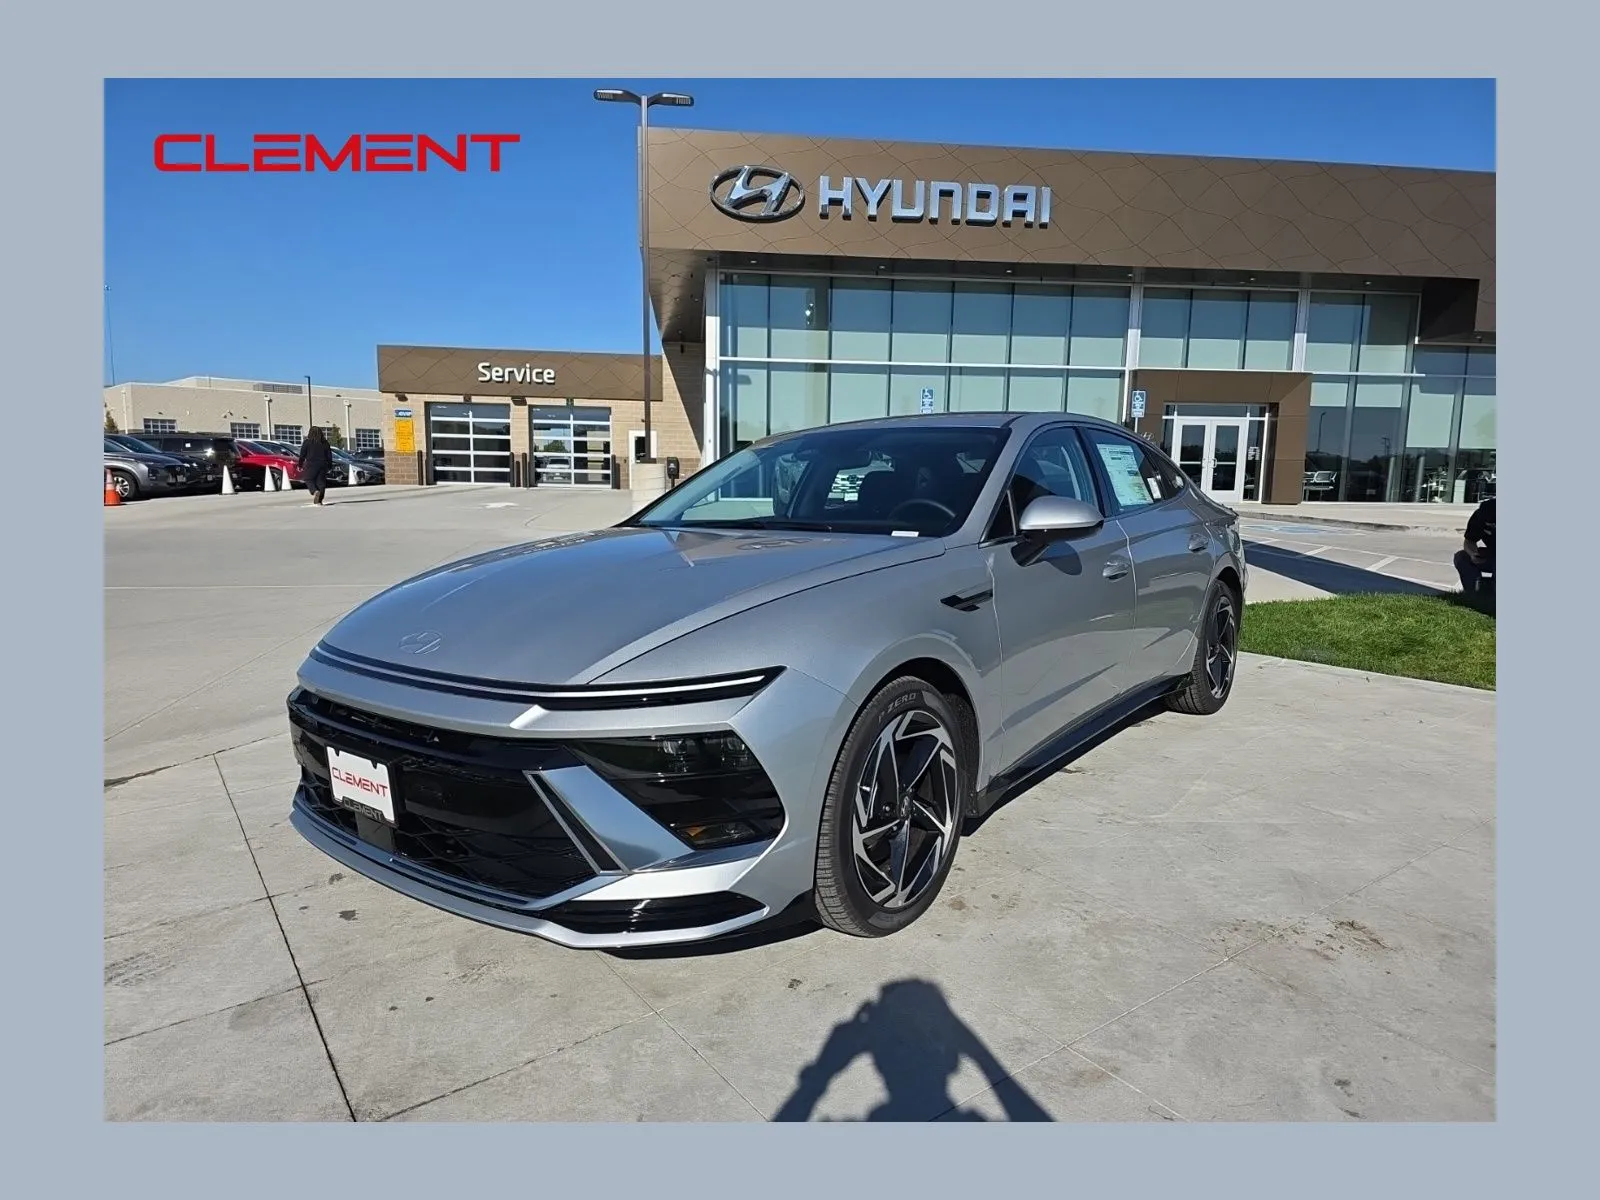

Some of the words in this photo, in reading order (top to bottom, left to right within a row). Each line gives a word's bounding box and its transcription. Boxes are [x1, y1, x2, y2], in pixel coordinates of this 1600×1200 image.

[819, 175, 1051, 229] HYUNDAI
[477, 362, 556, 384] Service
[887, 692, 917, 713] ZERO
[331, 766, 388, 797] CLEMENT
[343, 799, 382, 821] CLEMENT
